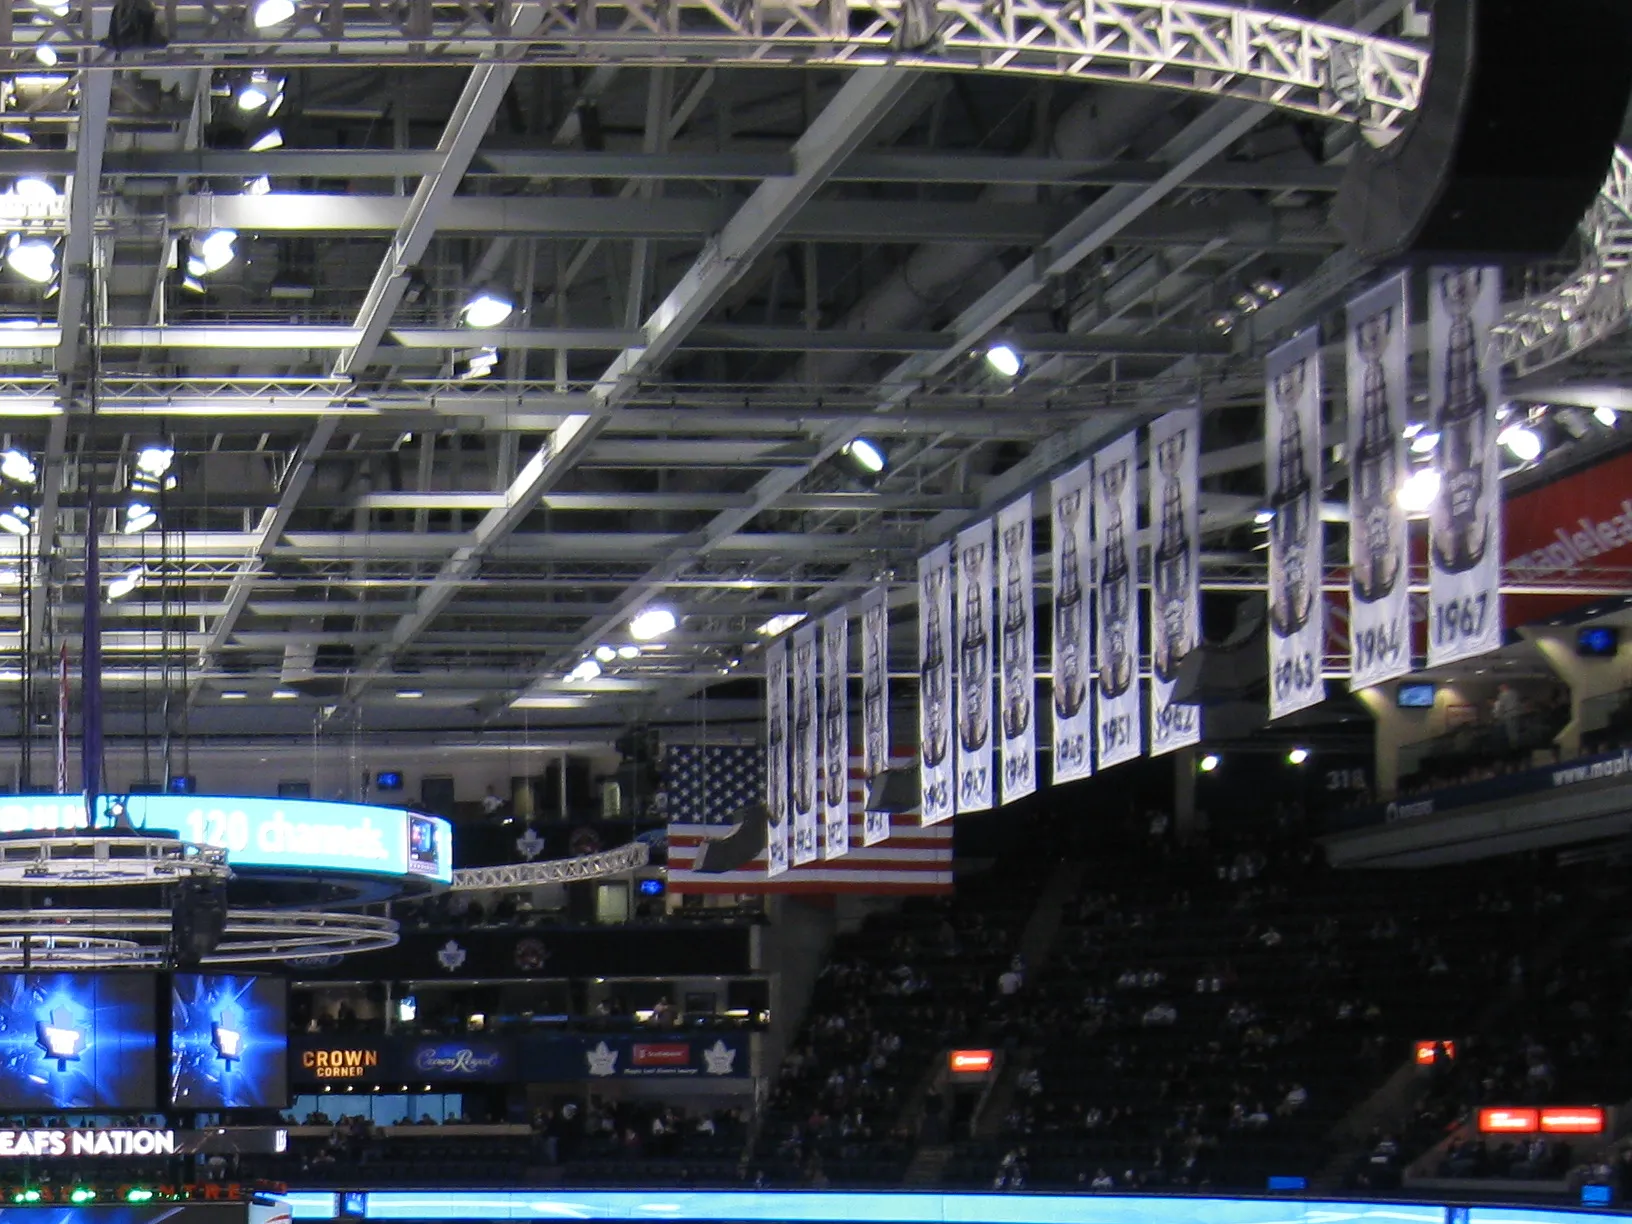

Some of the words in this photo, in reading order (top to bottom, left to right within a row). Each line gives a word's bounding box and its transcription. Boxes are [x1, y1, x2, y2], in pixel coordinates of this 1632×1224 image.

[1436, 588, 1488, 645] 1967
[1355, 617, 1400, 673] 1964
[303, 1049, 378, 1067] CROWN
[317, 1067, 365, 1078] CORNER
[71, 1130, 175, 1155] NATION
